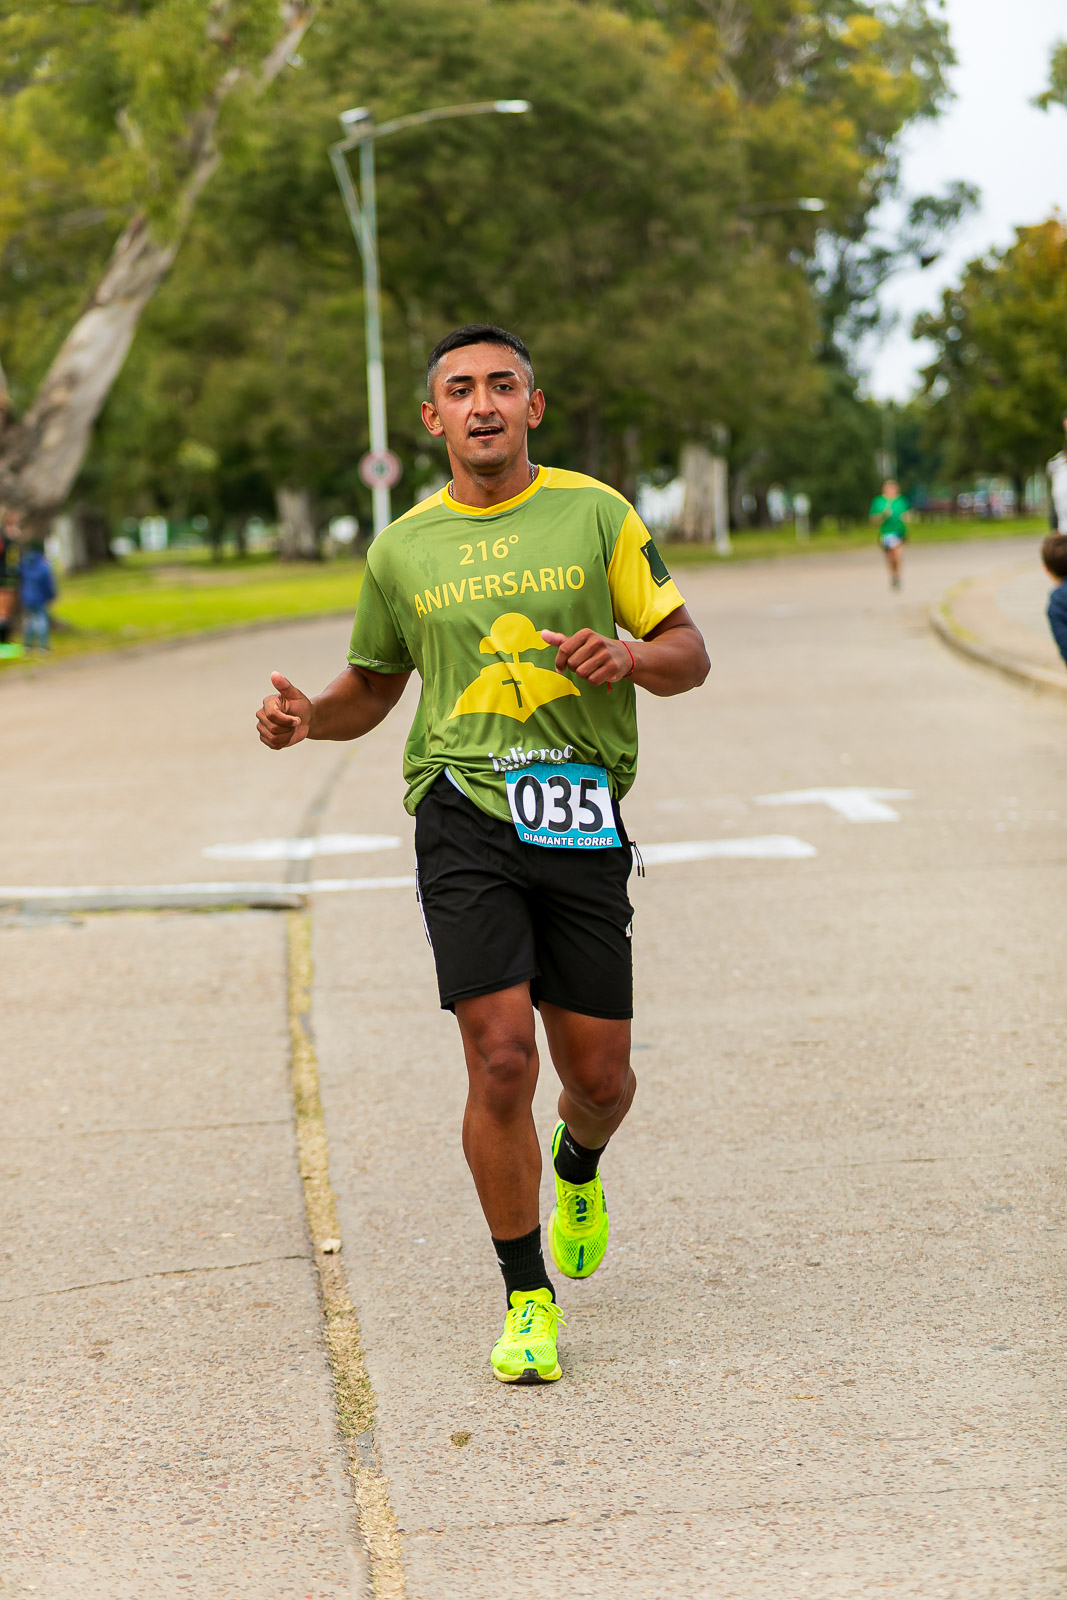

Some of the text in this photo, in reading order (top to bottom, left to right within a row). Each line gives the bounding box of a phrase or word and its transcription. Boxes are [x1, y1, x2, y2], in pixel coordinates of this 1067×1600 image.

[458, 534, 520, 566] 216°
[414, 565, 586, 618] ANIVERSARIO
[514, 774, 604, 834] 035
[523, 832, 614, 846] DIAMANTE CORRE
